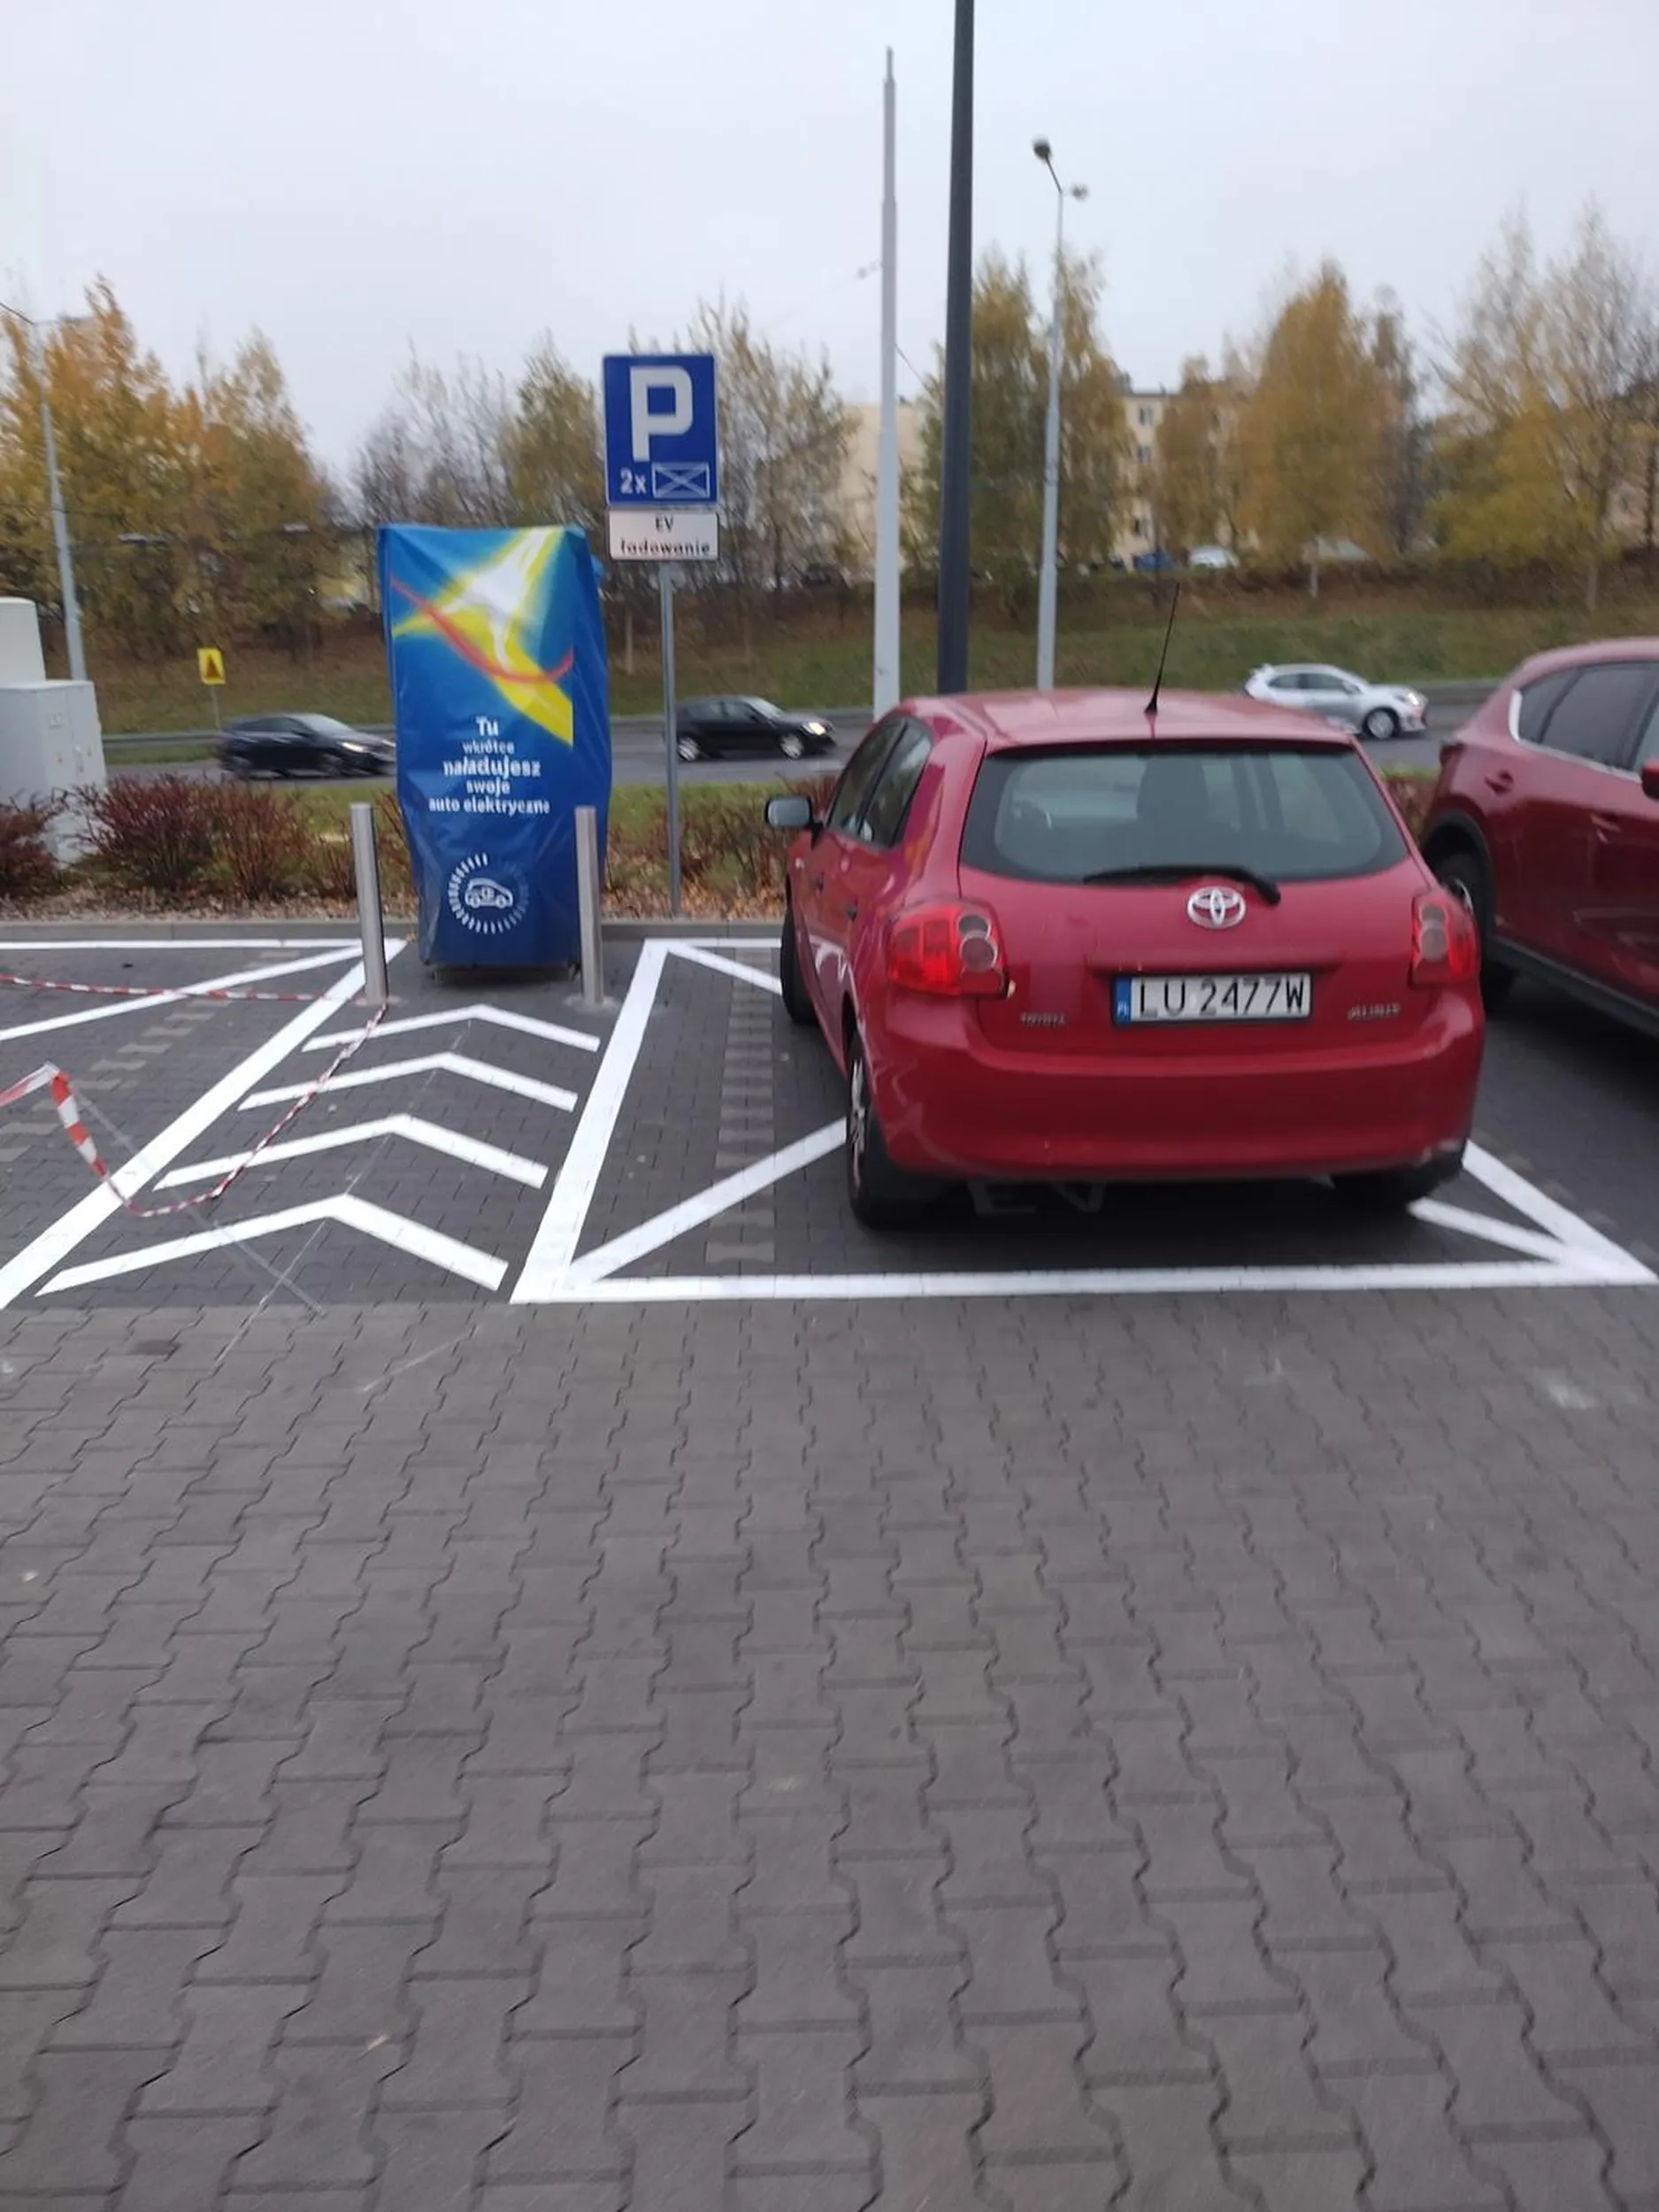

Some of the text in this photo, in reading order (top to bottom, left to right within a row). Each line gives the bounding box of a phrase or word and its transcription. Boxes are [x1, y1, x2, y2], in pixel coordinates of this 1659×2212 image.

[629, 365, 694, 462] P
[620, 467, 648, 494] 2x
[656, 516, 674, 531] EV
[475, 715, 499, 736] Tu
[461, 739, 515, 754] wkrótce
[465, 777, 511, 797] swoje
[428, 795, 550, 818] auto elektryczne
[1140, 977, 1186, 1018] LU
[1199, 974, 1305, 1018] 2477W
